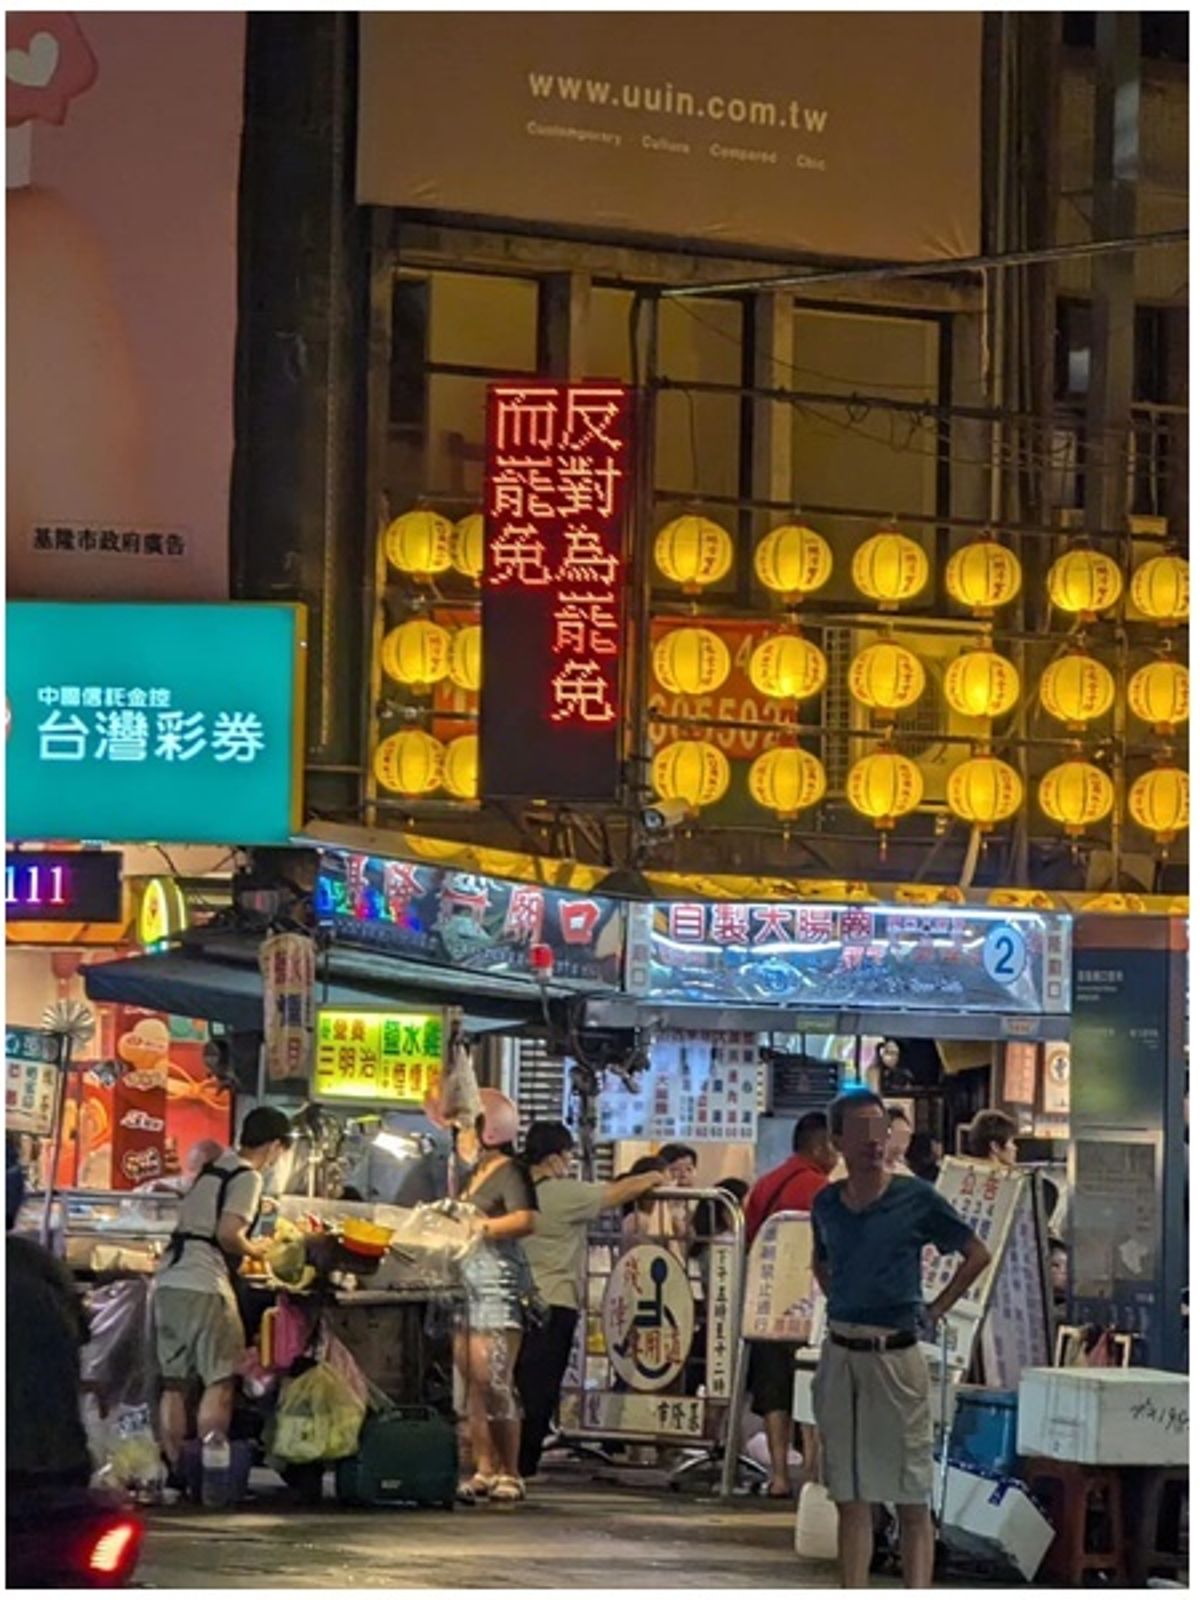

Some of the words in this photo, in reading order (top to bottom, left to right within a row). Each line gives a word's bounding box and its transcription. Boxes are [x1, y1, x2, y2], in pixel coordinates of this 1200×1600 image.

[528, 71, 828, 132] www.uuin.com.tw
[488, 387, 559, 586] 而罷免
[32, 527, 186, 557] 基隆市政府廣告
[550, 387, 625, 722] 反對為罷免
[37, 685, 172, 708] 中國信託金控
[37, 709, 265, 764] 台灣彩券
[994, 936, 1016, 974] 2
[318, 1045, 377, 1078] 三明治
